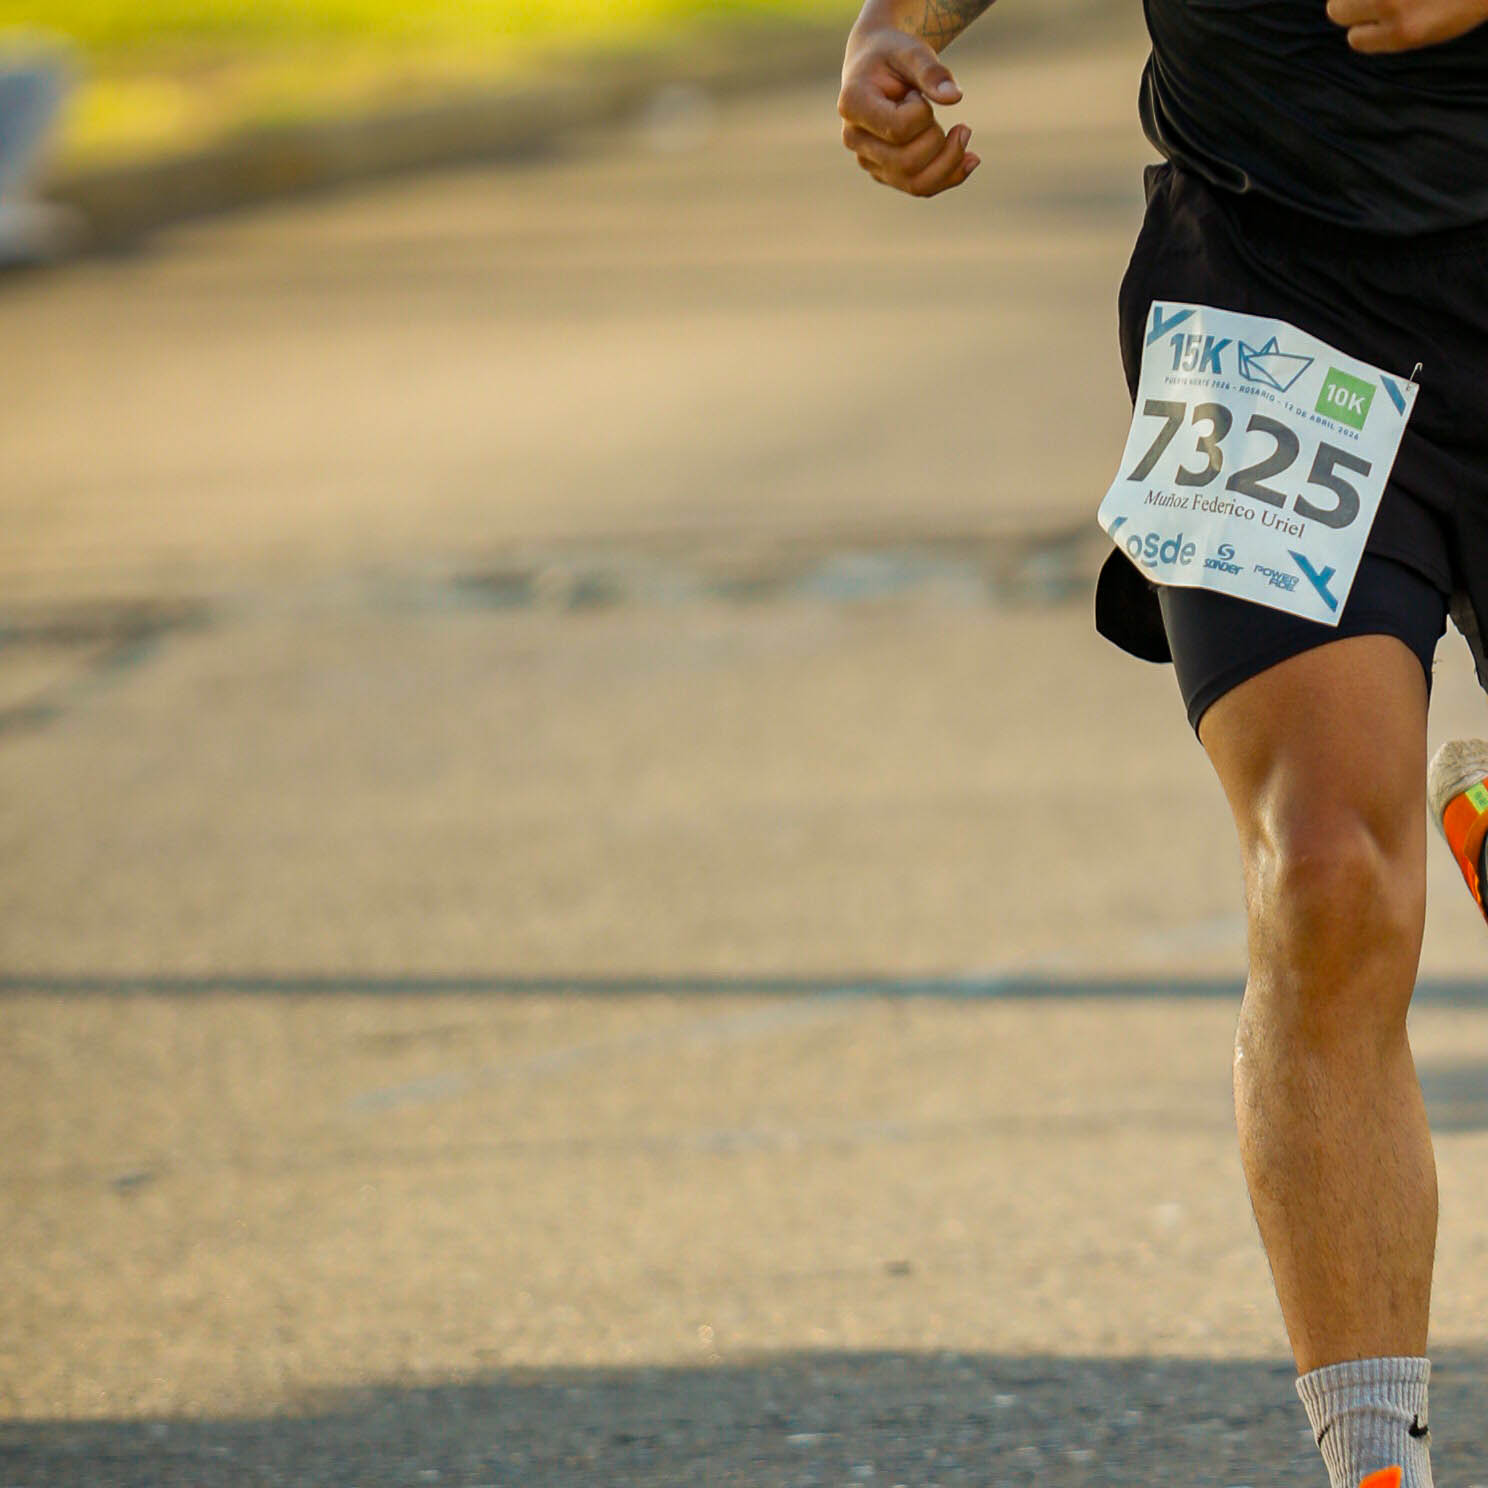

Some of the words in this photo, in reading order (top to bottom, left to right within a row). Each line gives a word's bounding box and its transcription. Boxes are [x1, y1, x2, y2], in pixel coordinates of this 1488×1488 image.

[1169, 333, 1233, 375] 15K
[1240, 385, 1276, 402] ROSARIO
[1310, 415, 1335, 430] ABRIL
[1327, 383, 1366, 415] 10K
[1126, 399, 1372, 529] 7325
[1144, 489, 1190, 510] Muñoz
[1192, 494, 1256, 521] Federico
[1261, 510, 1306, 539] Uriel
[1126, 532, 1197, 567] osde
